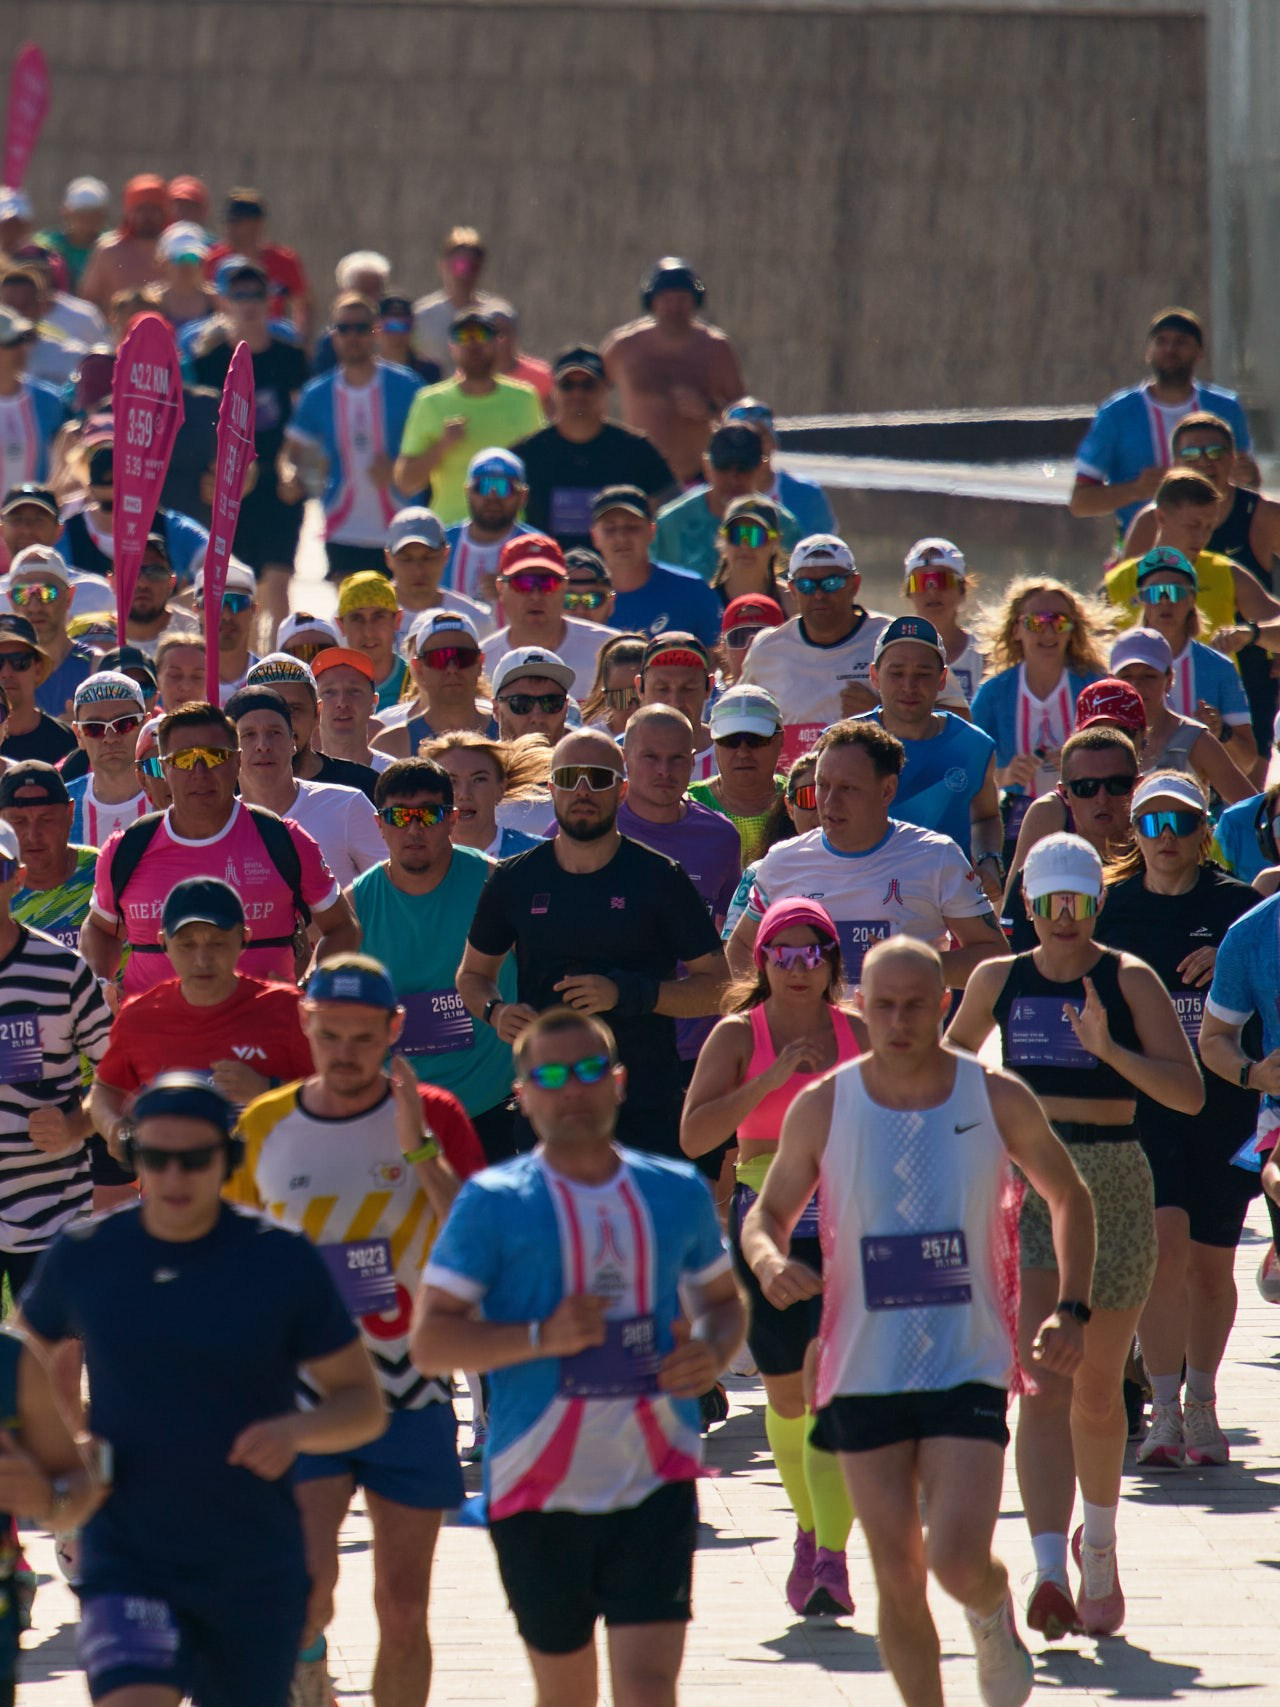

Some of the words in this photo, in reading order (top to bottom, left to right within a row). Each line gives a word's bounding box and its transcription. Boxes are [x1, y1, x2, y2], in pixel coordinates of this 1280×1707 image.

[127, 408, 153, 448] 3:59
[125, 454, 143, 478] 5.39
[852, 926, 886, 943] 2014
[431, 993, 465, 1013] 2556
[0, 1020, 35, 1041] 2176
[347, 1245, 387, 1269] 2023
[921, 1238, 961, 1260] 2574
